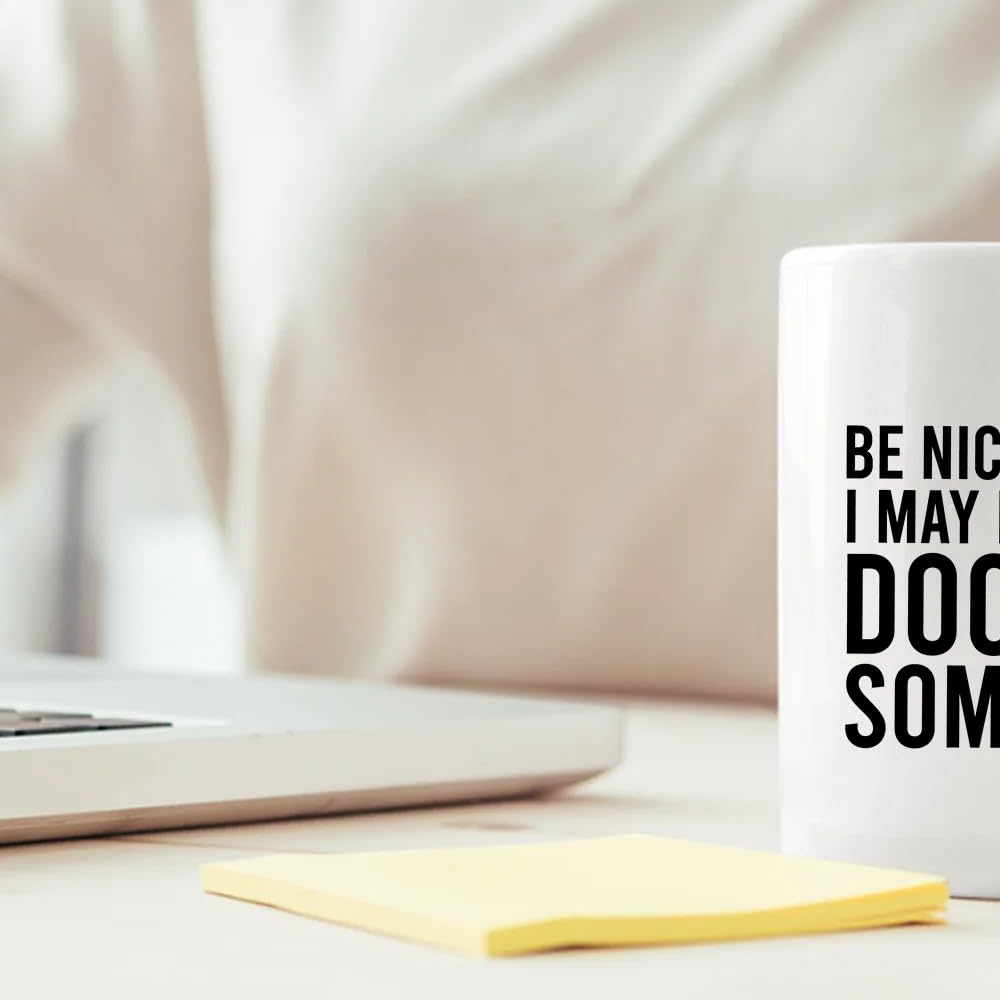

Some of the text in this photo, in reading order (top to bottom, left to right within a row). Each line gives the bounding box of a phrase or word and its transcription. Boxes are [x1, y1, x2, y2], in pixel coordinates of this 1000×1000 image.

[846, 424, 904, 480] BE
[846, 489, 857, 544] I
[878, 489, 980, 544] MAY
